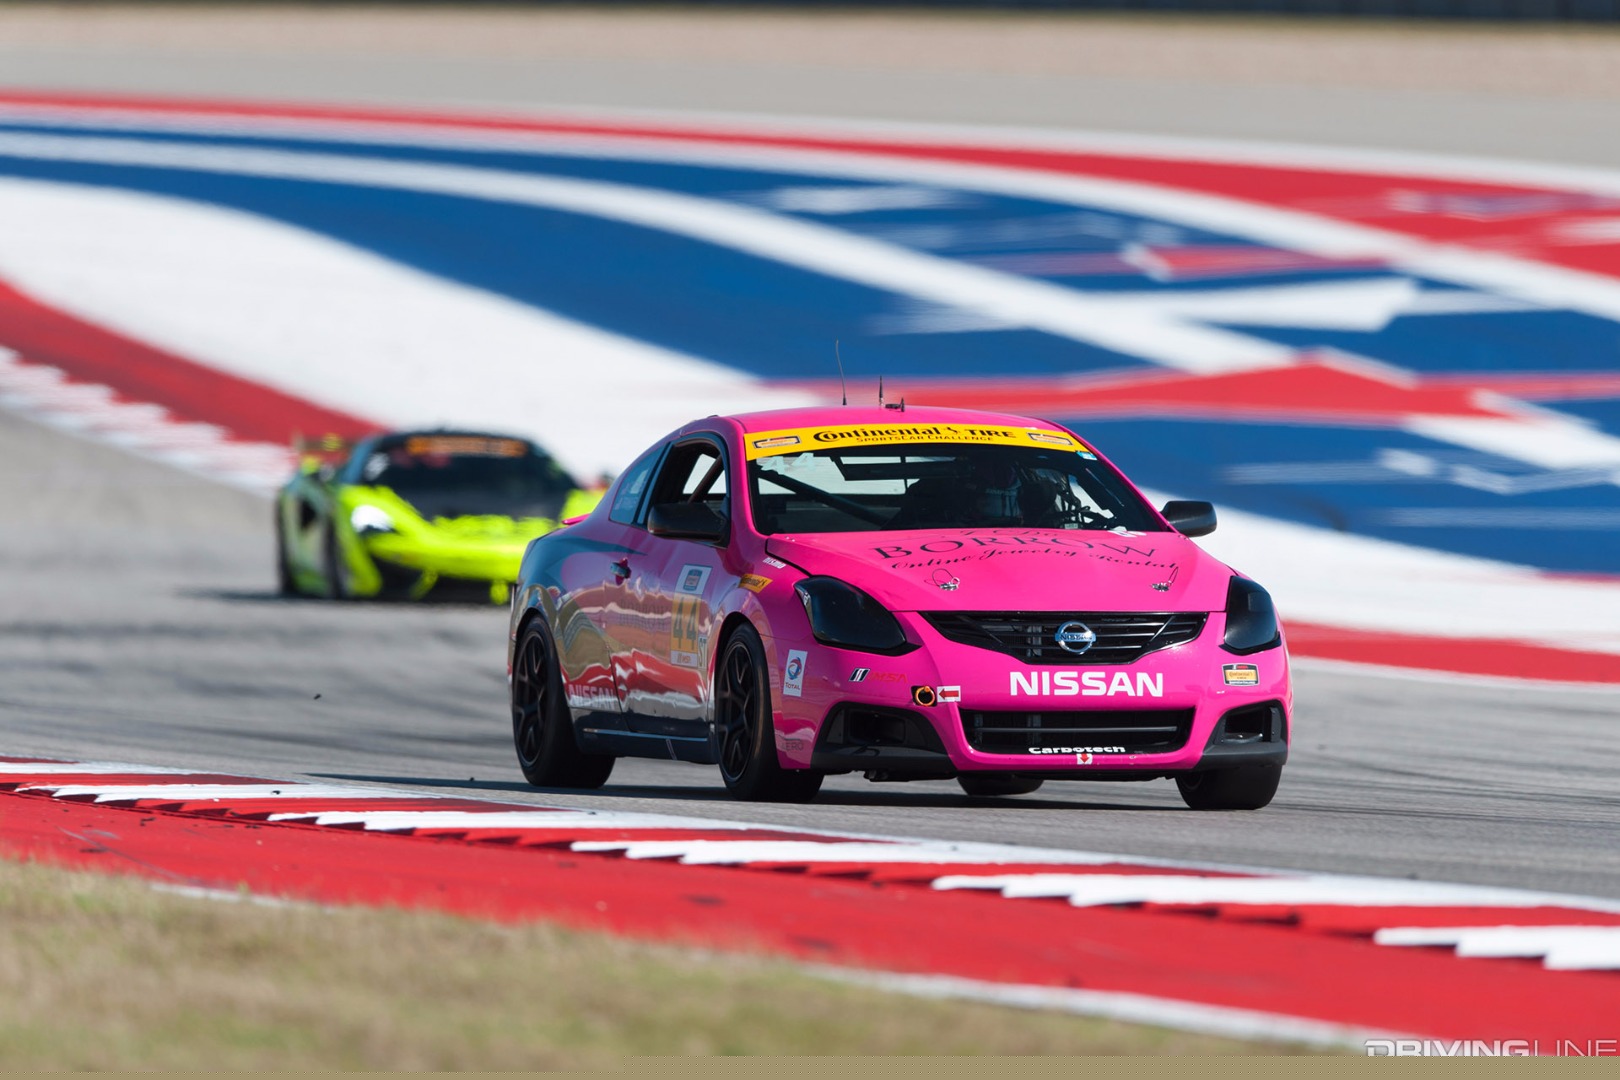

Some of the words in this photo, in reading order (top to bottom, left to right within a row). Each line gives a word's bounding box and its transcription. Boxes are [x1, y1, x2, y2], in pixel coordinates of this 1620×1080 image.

[813, 427, 941, 442] Continental
[964, 429, 1016, 438] TIRE
[869, 537, 1156, 559] BORROW
[891, 555, 975, 569] Online
[979, 548, 1077, 561] Jewelry
[673, 596, 698, 651] 44
[785, 682, 801, 691] TOTAL
[1009, 671, 1163, 697] NISSAN
[568, 684, 617, 709] NISSAN
[1028, 746, 1126, 754] Carbotech
